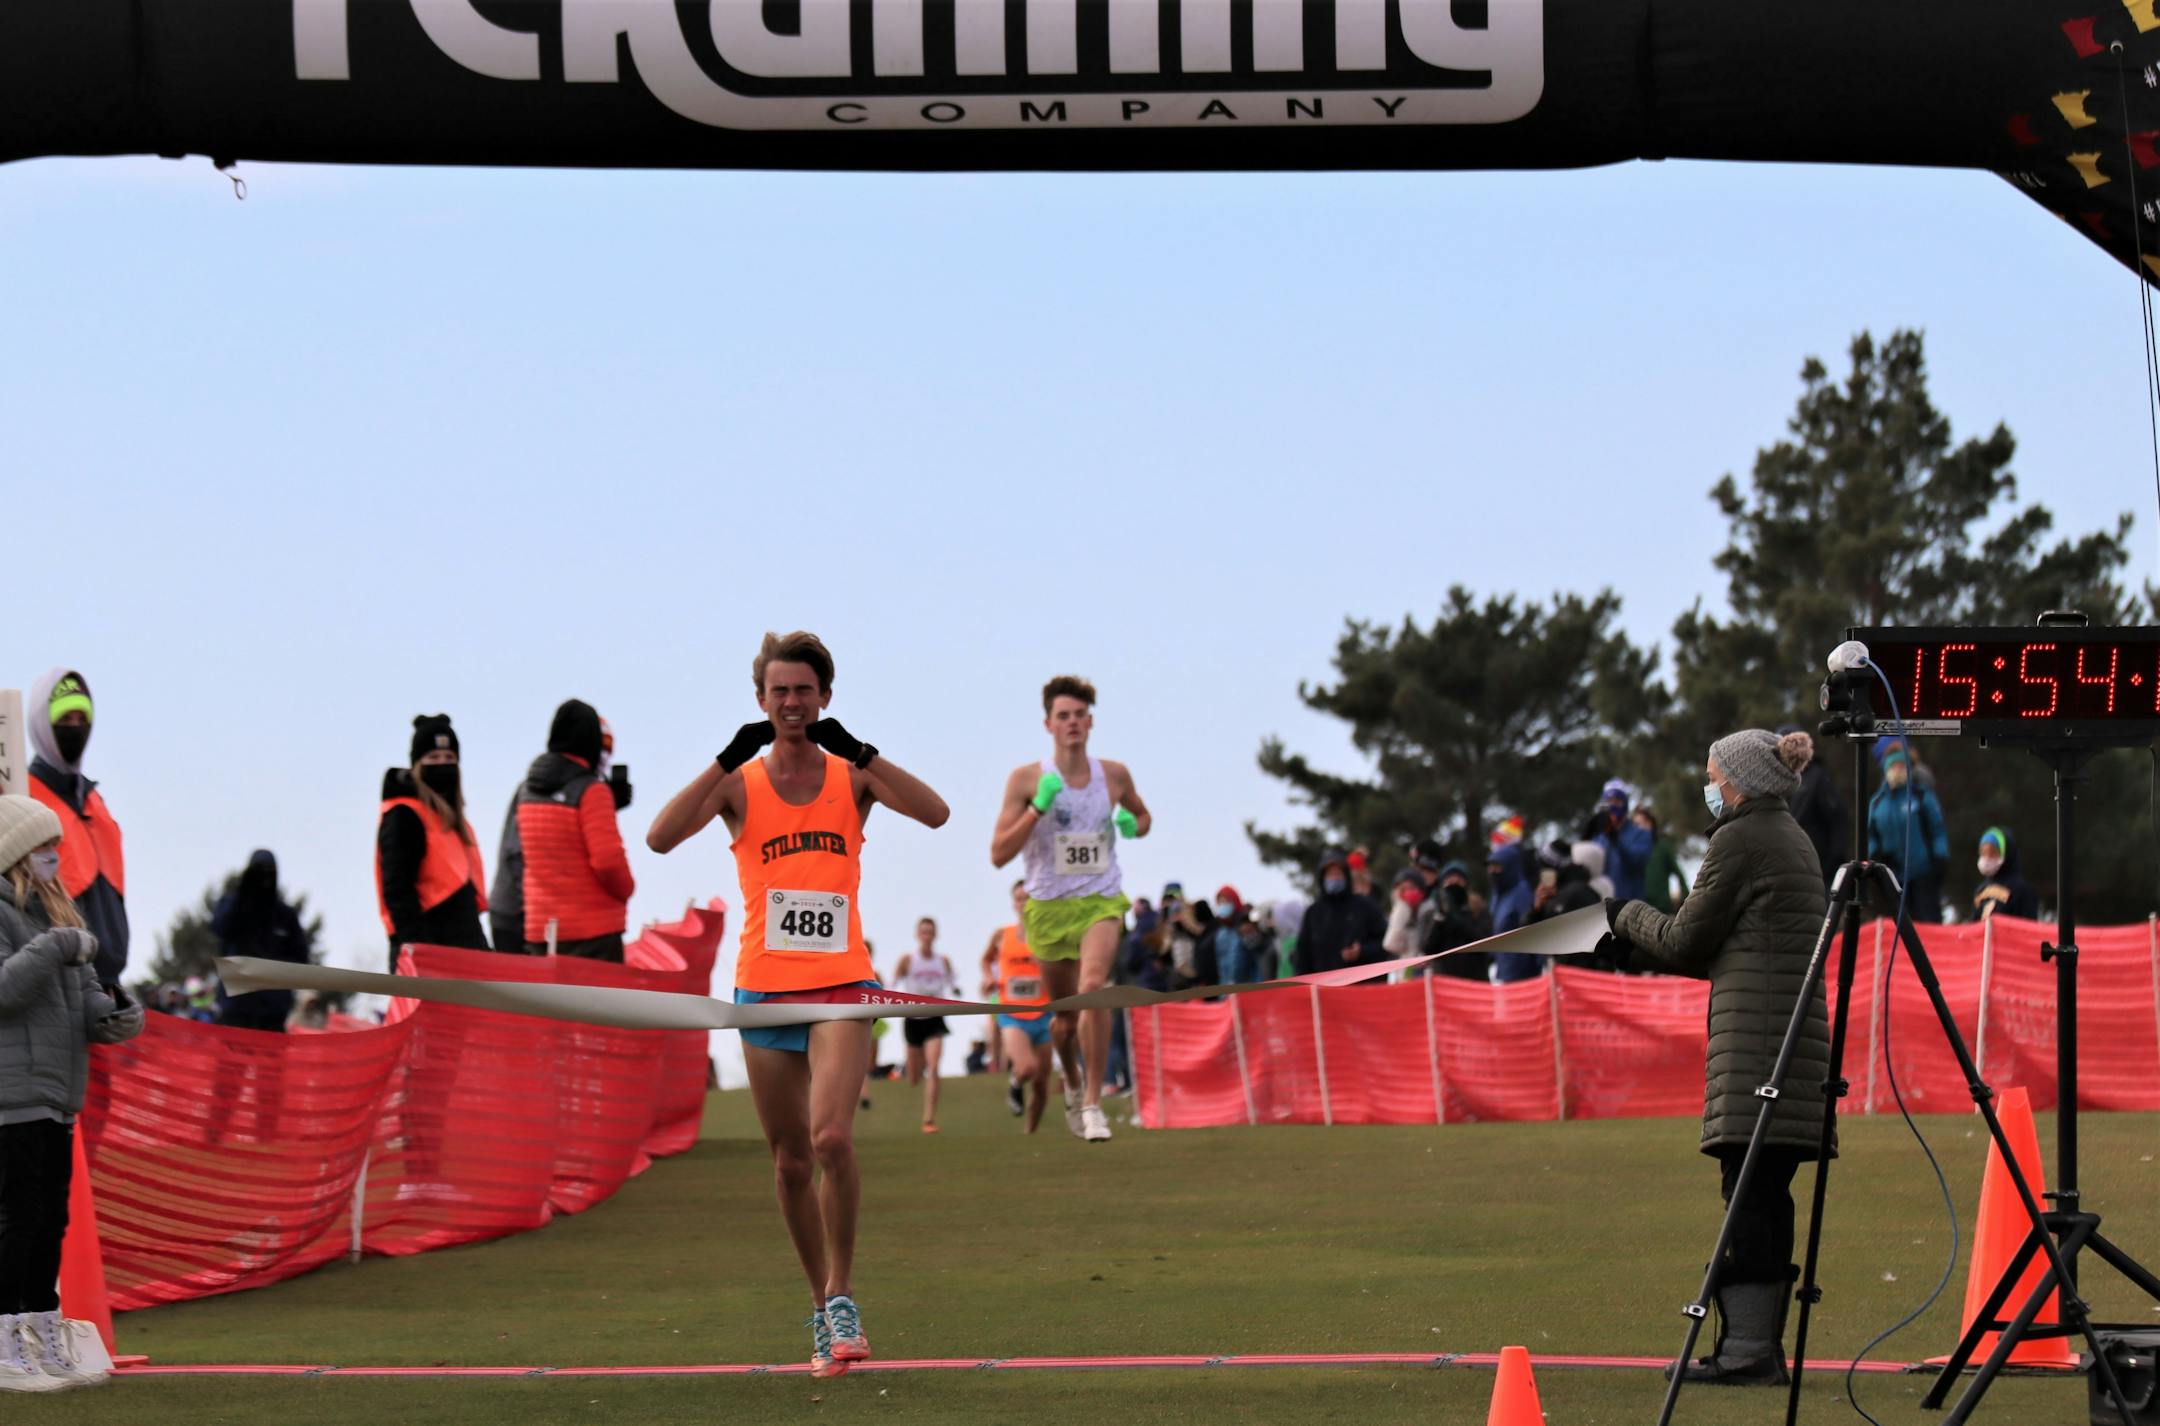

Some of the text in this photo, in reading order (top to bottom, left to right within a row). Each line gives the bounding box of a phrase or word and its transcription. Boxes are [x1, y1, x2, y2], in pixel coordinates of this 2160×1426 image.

[826, 96, 1406, 124] COMPANY
[761, 831, 848, 864] STILLWATER
[1066, 846, 1099, 865] 381
[780, 910, 834, 937] 488
